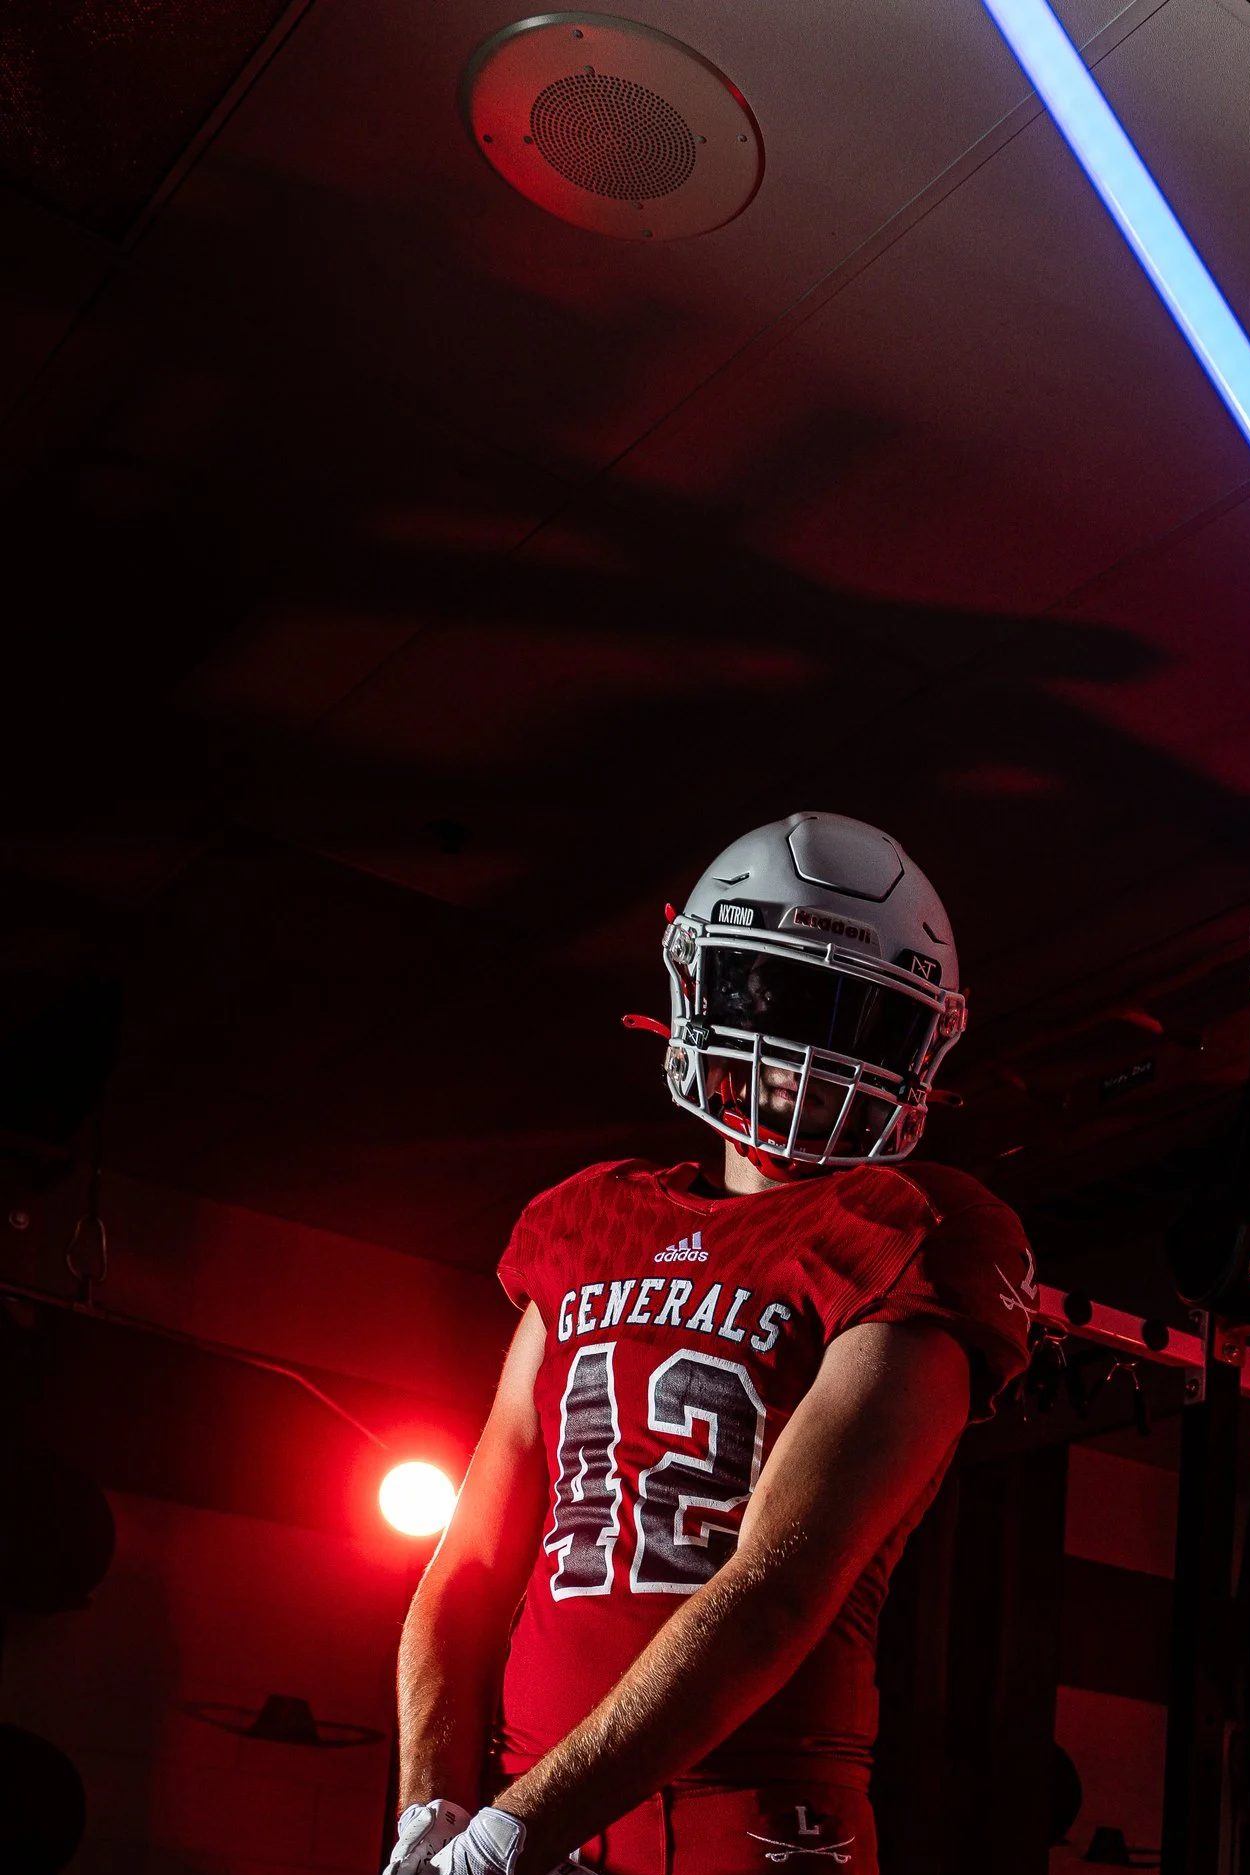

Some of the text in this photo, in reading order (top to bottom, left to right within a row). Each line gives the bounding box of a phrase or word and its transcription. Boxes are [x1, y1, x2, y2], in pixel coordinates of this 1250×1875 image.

[718, 903, 755, 927] NXTRND
[793, 908, 872, 945] Riddell
[653, 1247, 710, 1264] adidas
[555, 1276, 792, 1355] GENERALS
